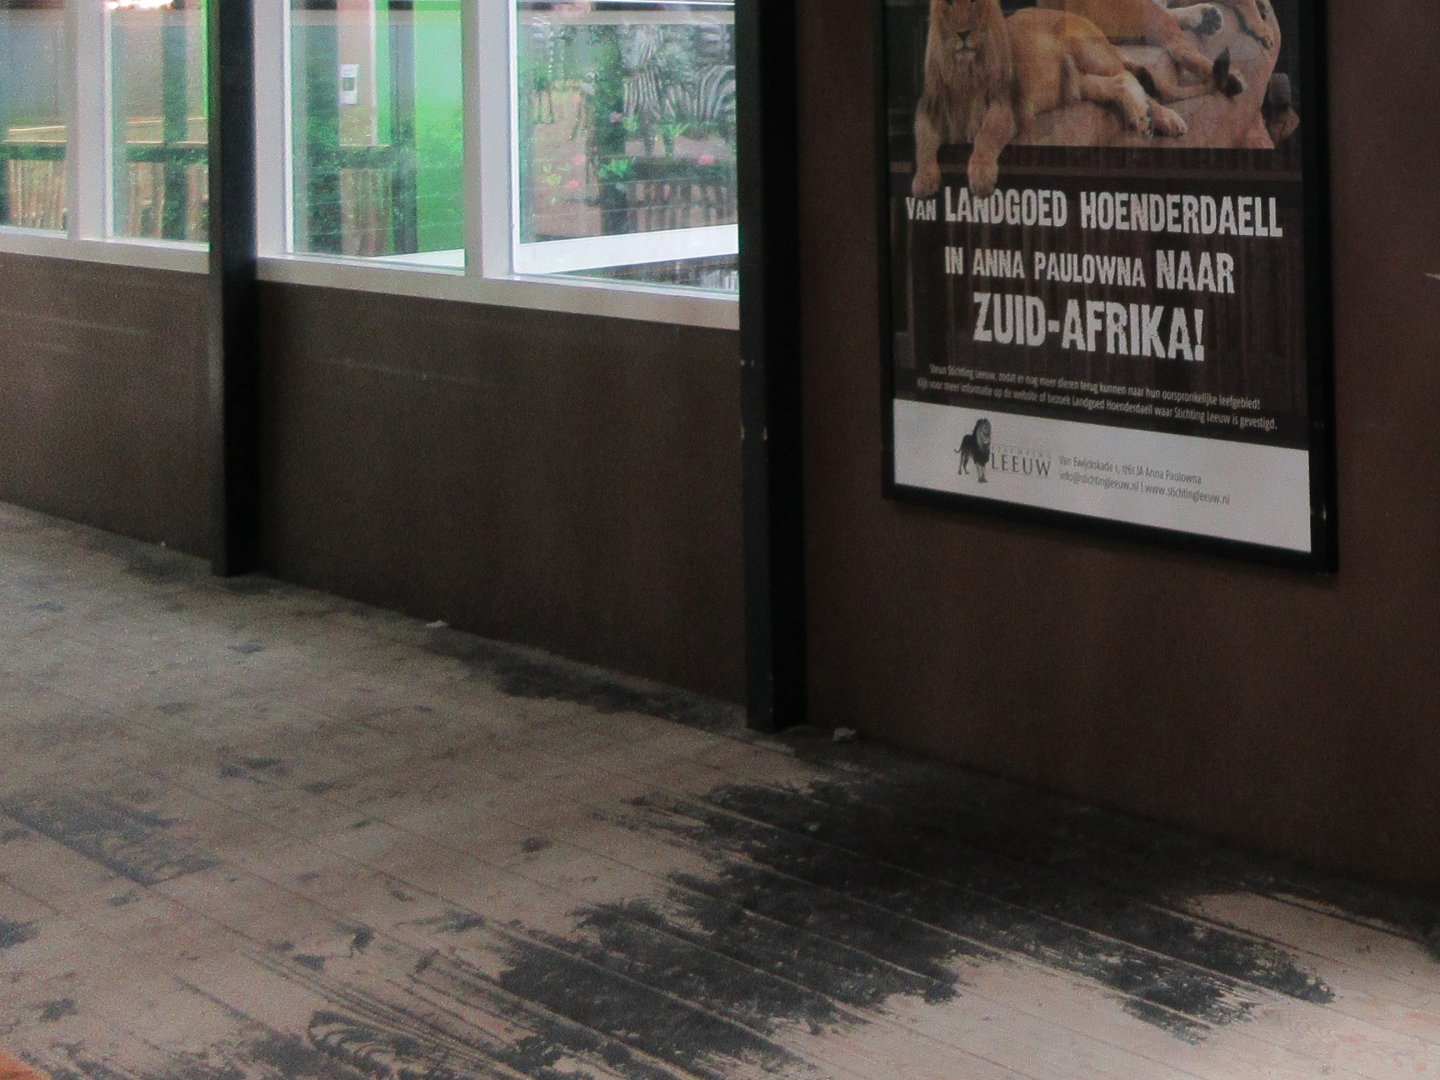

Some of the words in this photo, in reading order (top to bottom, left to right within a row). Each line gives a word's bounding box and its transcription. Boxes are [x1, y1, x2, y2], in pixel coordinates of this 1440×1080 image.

[905, 196, 937, 221] VAN
[944, 186, 1068, 227] LANDGOED
[1080, 191, 1283, 238] HOENDERDAELL
[944, 246, 963, 275] IN
[972, 248, 1025, 279] ANNA
[1034, 252, 1146, 287] PAULOWNA
[1155, 250, 1235, 294] NAAR
[973, 292, 1205, 362] ZUID-AFRIKA!
[1057, 378, 1079, 390] dieren
[1080, 380, 1099, 395] terug
[1100, 381, 1127, 396] kunnen
[1128, 386, 1145, 398] naar
[1146, 386, 1161, 399] hun
[1162, 389, 1218, 407] oorspronkelijke
[1219, 394, 1261, 411] leefgebied!
[1072, 395, 1105, 410] Landgoed
[1106, 399, 1153, 415] Hoenderdaell
[1154, 406, 1173, 417] waar
[1174, 406, 1205, 424] Stichting
[1206, 410, 1231, 424] Leeuw
[1232, 413, 1239, 425] is
[1240, 415, 1278, 431] gevestigd.
[991, 452, 1051, 477] LEEUW
[1145, 466, 1164, 480] Anna
[1165, 469, 1202, 485] Paulowna
[1145, 483, 1231, 506] www.stichtingleeuw.nl
